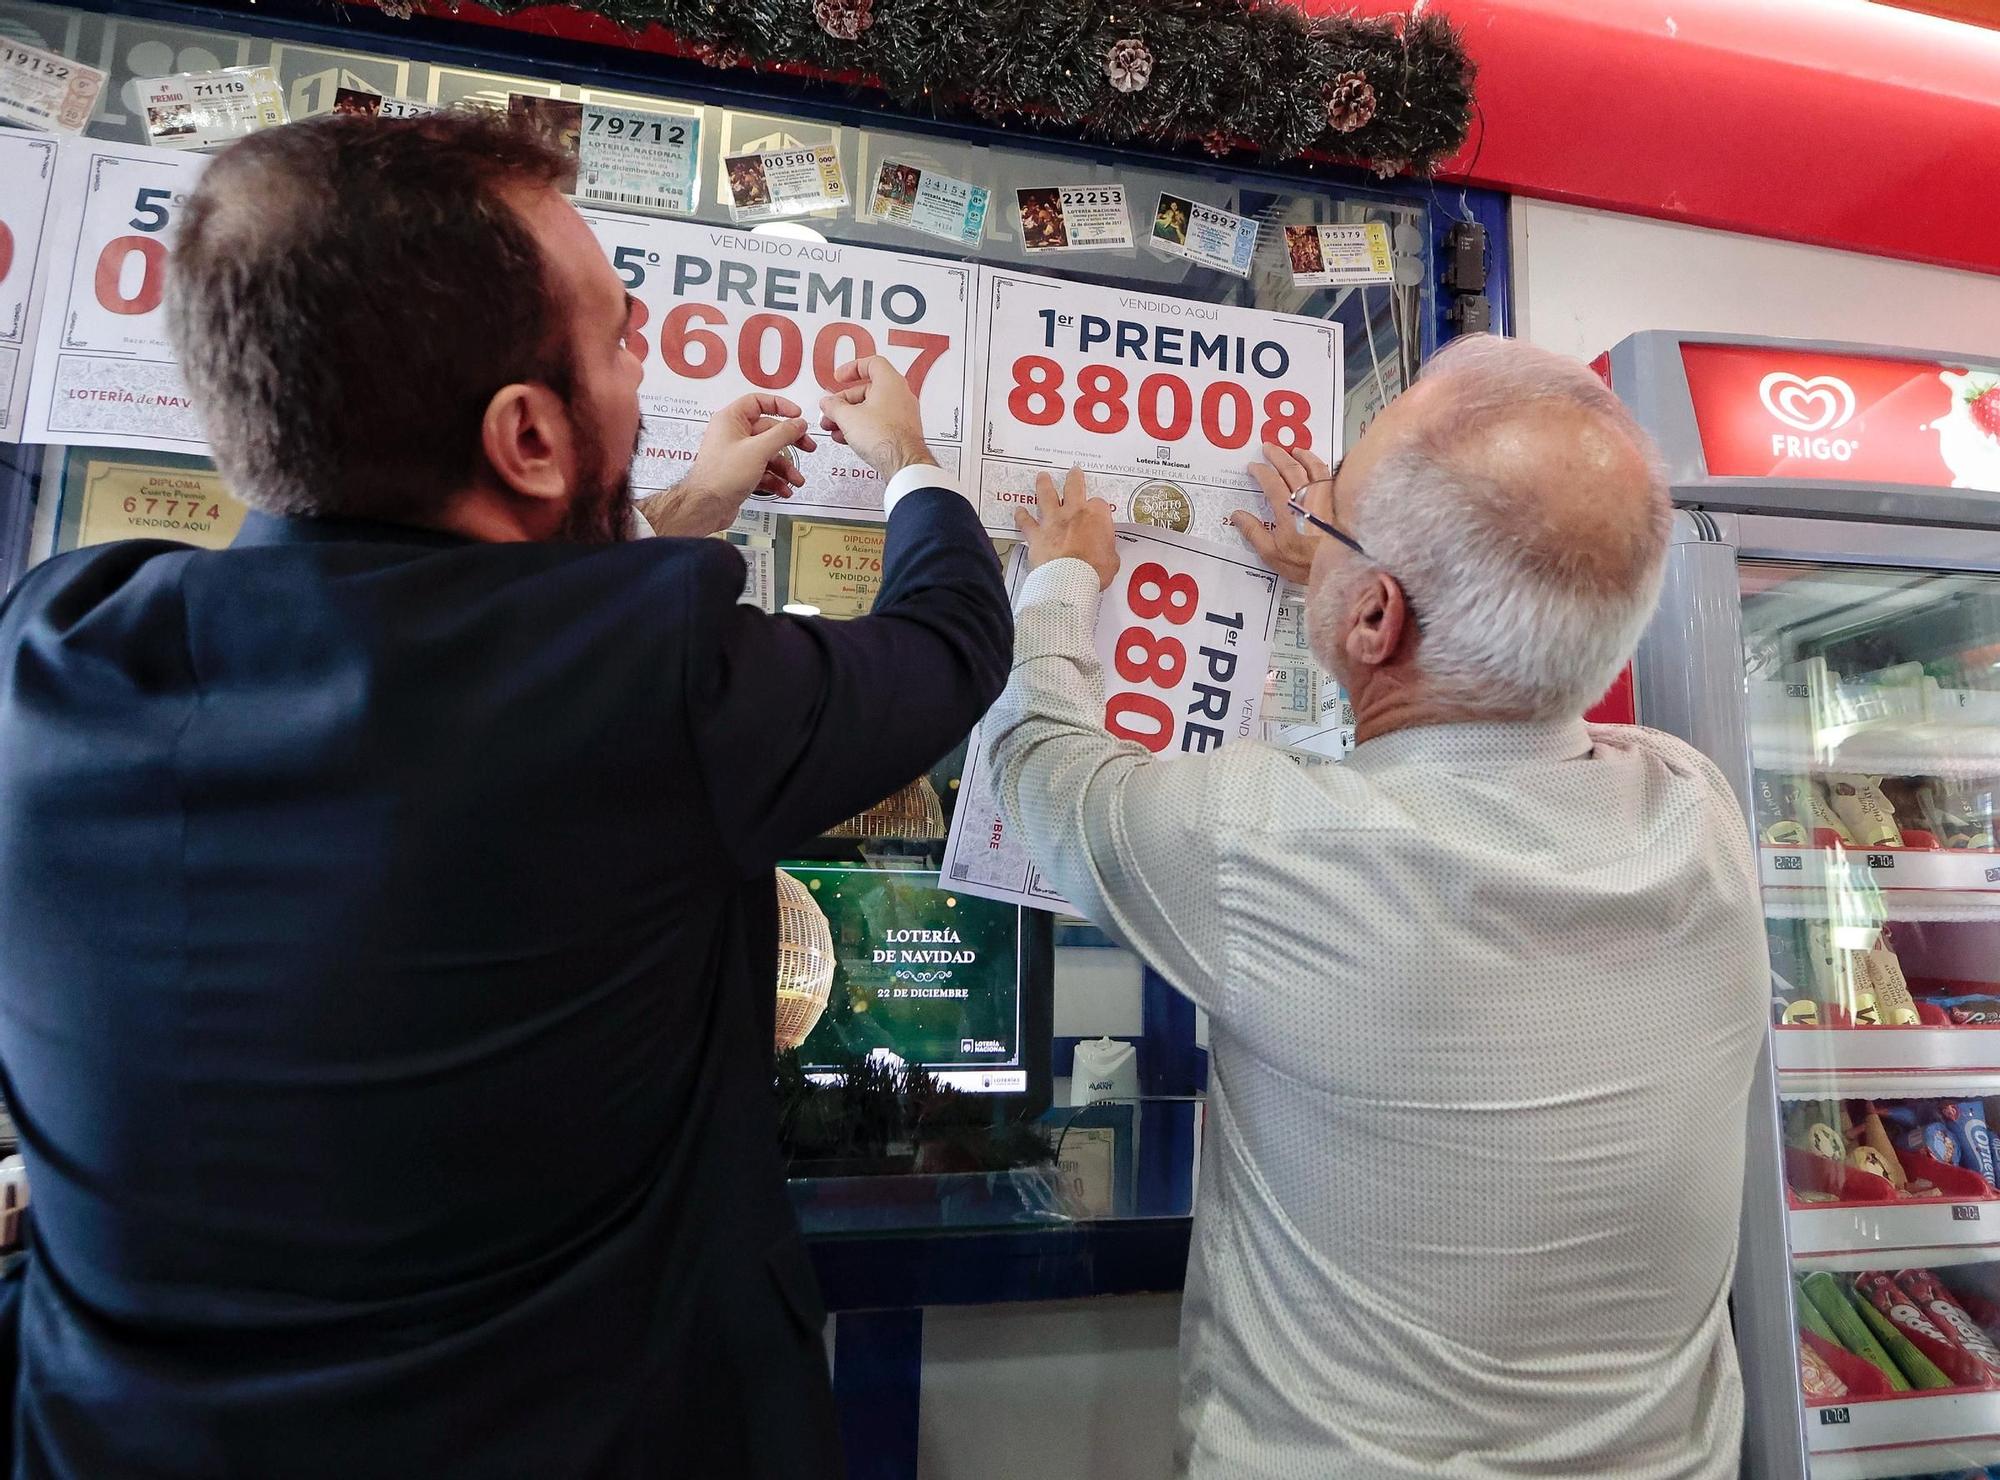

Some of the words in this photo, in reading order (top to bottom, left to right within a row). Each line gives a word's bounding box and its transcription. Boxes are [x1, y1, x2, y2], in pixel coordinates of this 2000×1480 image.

[5, 48, 69, 80] 19152
[193, 82, 245, 96] 71119
[150, 93, 183, 103] PREMIO
[588, 113, 685, 145] 79712
[634, 144, 683, 159] NACIONAL
[764, 152, 815, 169] 00580
[828, 182, 839, 190] 20
[924, 177, 967, 198] 34154
[1062, 191, 1122, 205] 22253
[1192, 208, 1238, 230] 64992
[1325, 231, 1361, 239] 95379
[710, 233, 793, 257] VENDIDO
[797, 245, 843, 264] AQUÍ
[613, 246, 661, 289] 5º
[672, 253, 927, 325] PREMIO
[1119, 296, 1181, 315] VENDIDO
[1184, 301, 1220, 321] AQUÍ
[1039, 309, 1074, 348] 1er
[1079, 314, 1290, 378] PREMIO
[69, 387, 134, 404] LOTERÍA
[136, 393, 154, 405] de
[1007, 354, 1313, 452] 88008
[653, 404, 669, 412] NO
[670, 407, 692, 416] HAY
[1772, 434, 1853, 461] FRIGO
[1087, 462, 1105, 470] HAY
[1106, 464, 1137, 473] MAYOR
[1137, 467, 1168, 476] SUERTE
[1162, 460, 1191, 469] Nacional
[831, 466, 846, 477] 22
[851, 468, 883, 480] DICI
[149, 477, 201, 490] DIPLOMA
[140, 486, 171, 498] Cuarto
[173, 489, 206, 500] Premio
[997, 491, 1038, 505] LOTERÍ
[123, 496, 220, 520] 67774
[128, 517, 180, 528] VENDIDO
[183, 519, 211, 532] AQUÍ
[844, 535, 885, 546] DIPLOMA
[852, 545, 882, 554] Aciertos
[829, 572, 871, 583] VENDIDO
[1239, 697, 1255, 739] VEND
[886, 927, 961, 943] LOTERÍA
[872, 950, 896, 963] DE
[900, 950, 976, 963] NAVIDAD
[877, 989, 890, 997] 22
[893, 989, 909, 997] DE
[911, 989, 968, 998] DICIEMBRE
